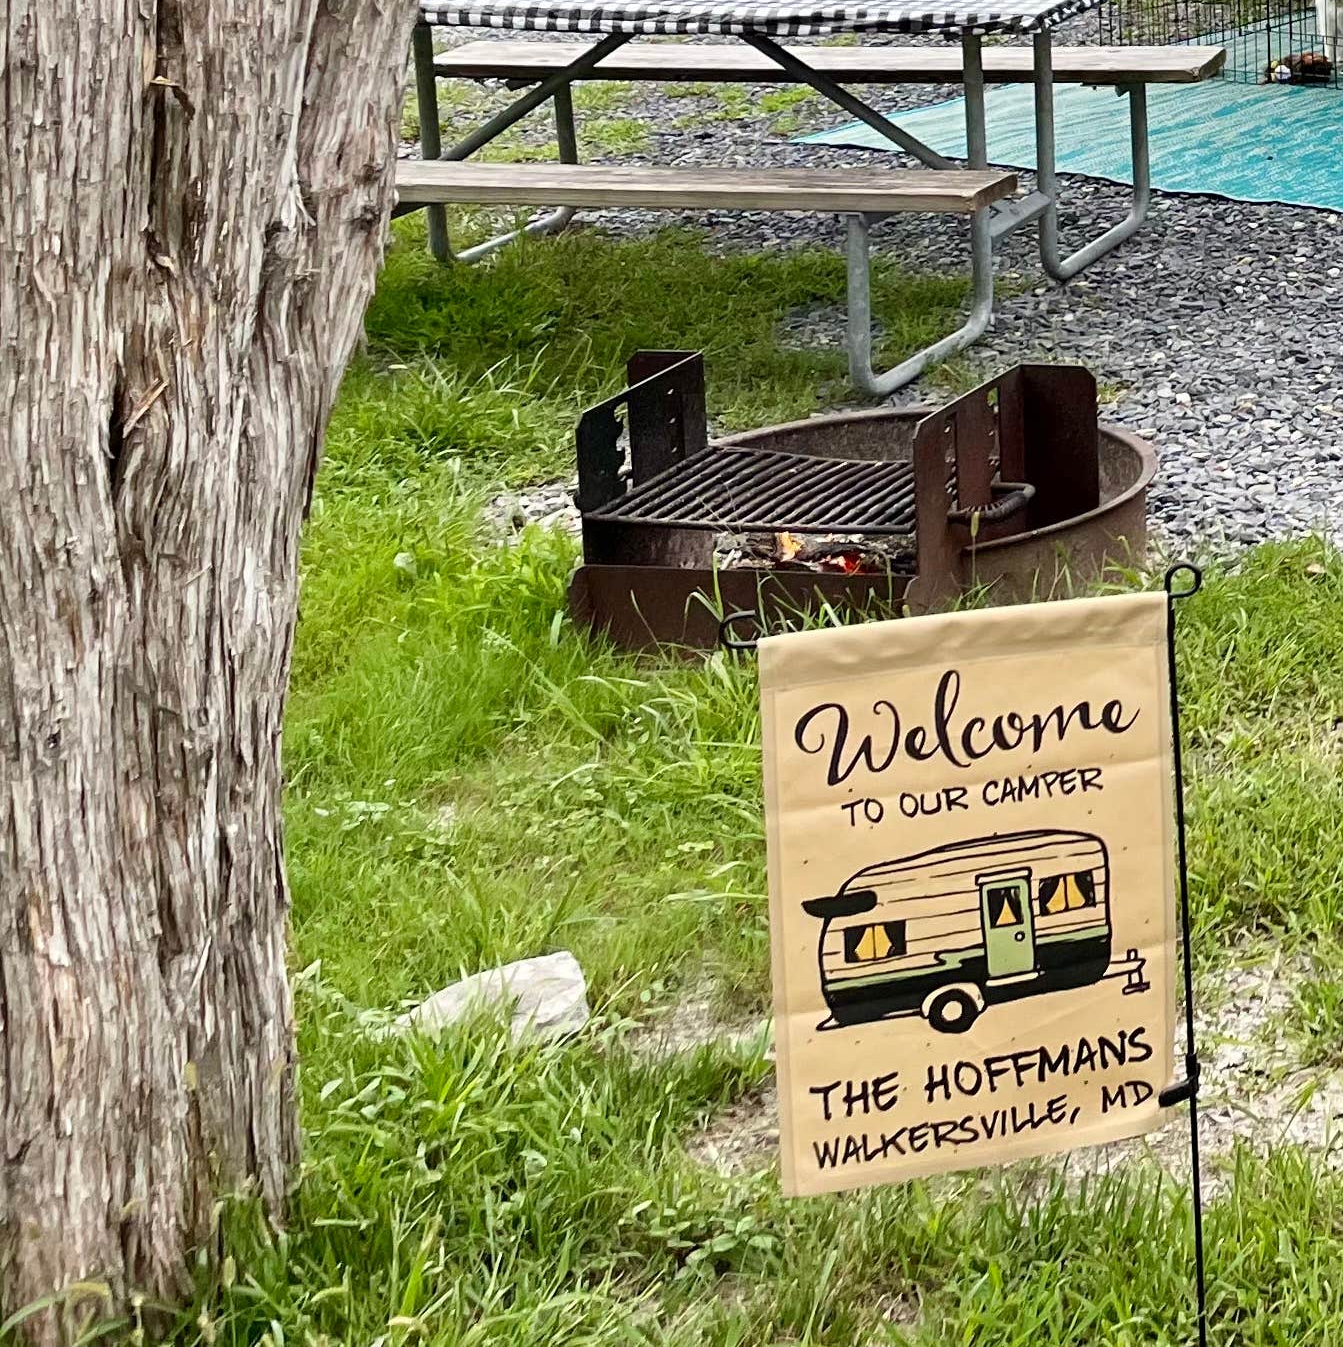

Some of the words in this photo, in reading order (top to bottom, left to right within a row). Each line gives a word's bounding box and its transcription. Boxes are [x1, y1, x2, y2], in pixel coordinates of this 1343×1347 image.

[794, 669, 1141, 787] Welcome
[841, 798, 885, 827] TO
[900, 786, 970, 819] OUR
[982, 767, 1104, 807] CAMPER
[809, 1071, 900, 1121] THE
[923, 1026, 1154, 1103] HOFFMANS
[813, 1094, 1081, 1169] WALKERSVILLE,
[1101, 1080, 1154, 1113] MD
